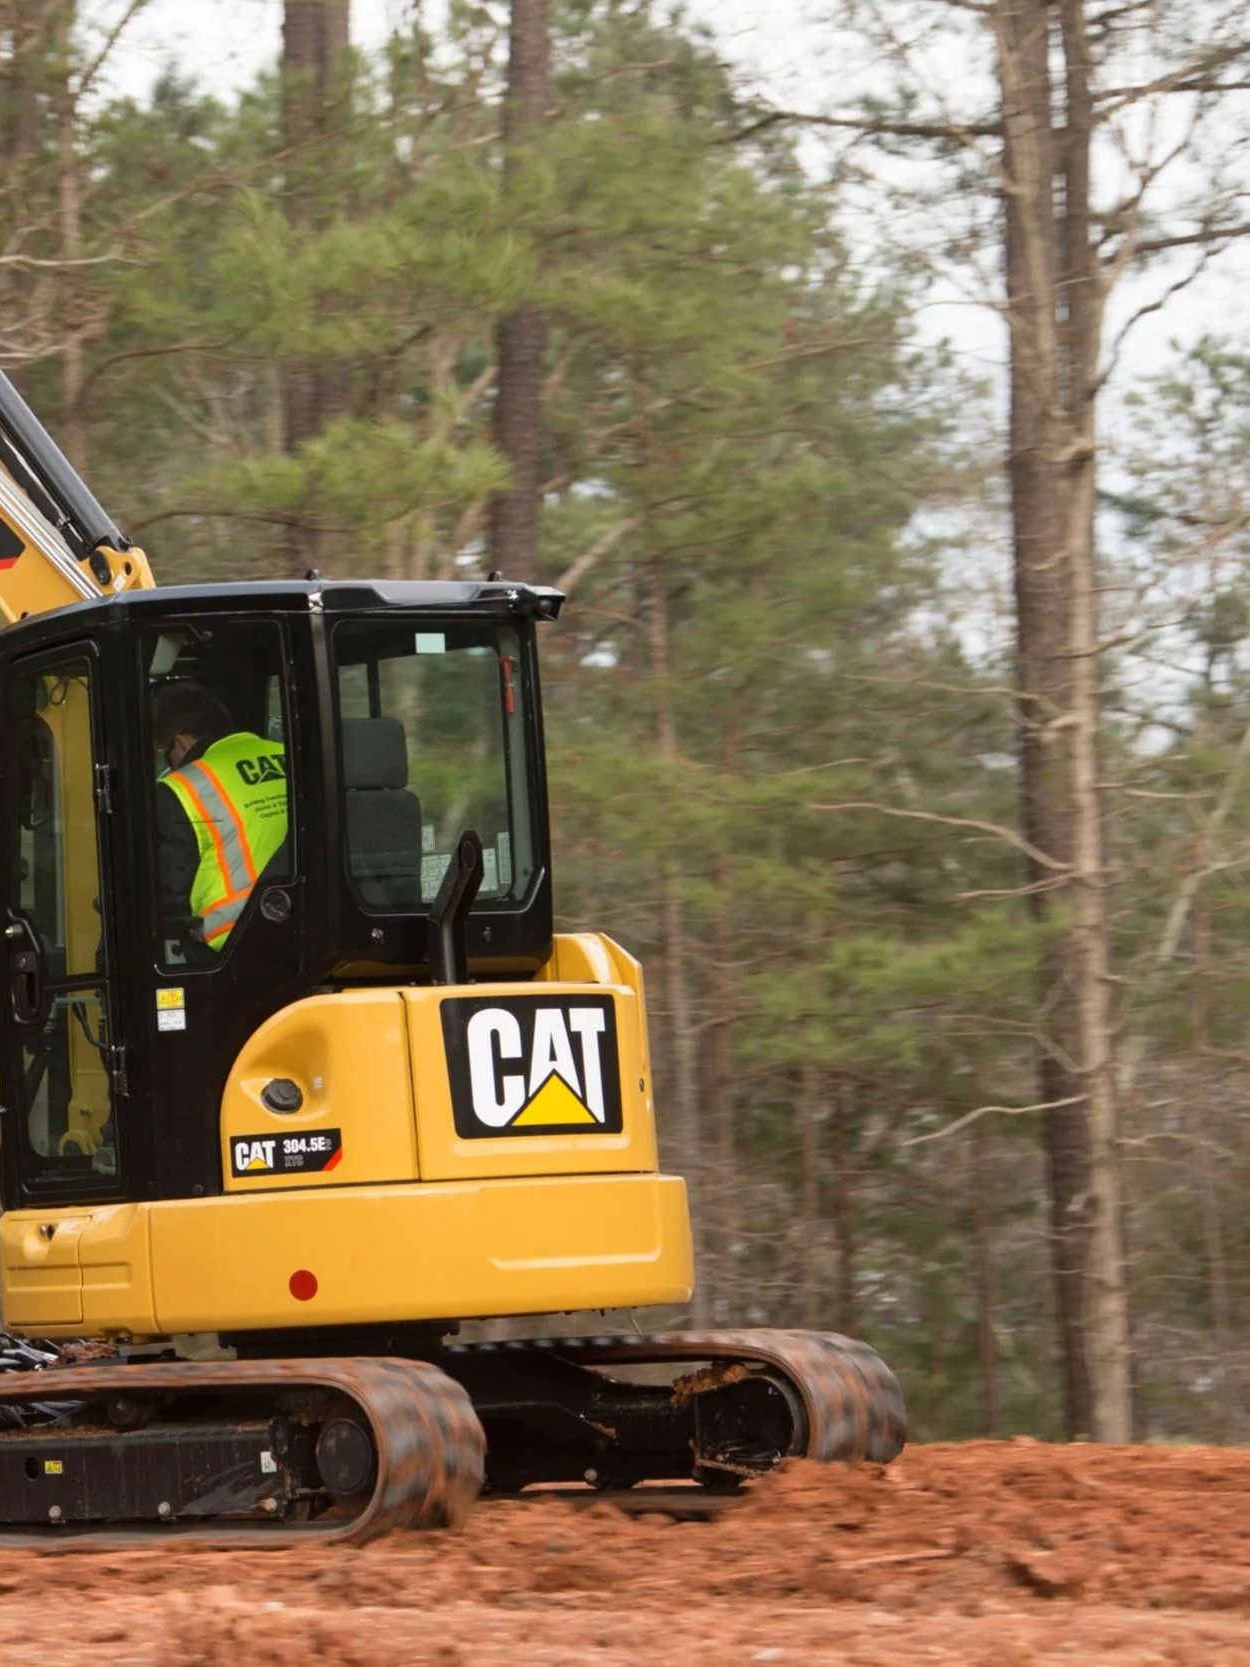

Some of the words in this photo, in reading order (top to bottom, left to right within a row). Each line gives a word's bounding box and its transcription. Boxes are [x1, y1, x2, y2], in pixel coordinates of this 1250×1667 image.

[235, 753, 286, 785] CAT
[467, 1008, 605, 1127] CAT
[235, 1140, 276, 1170] CAT
